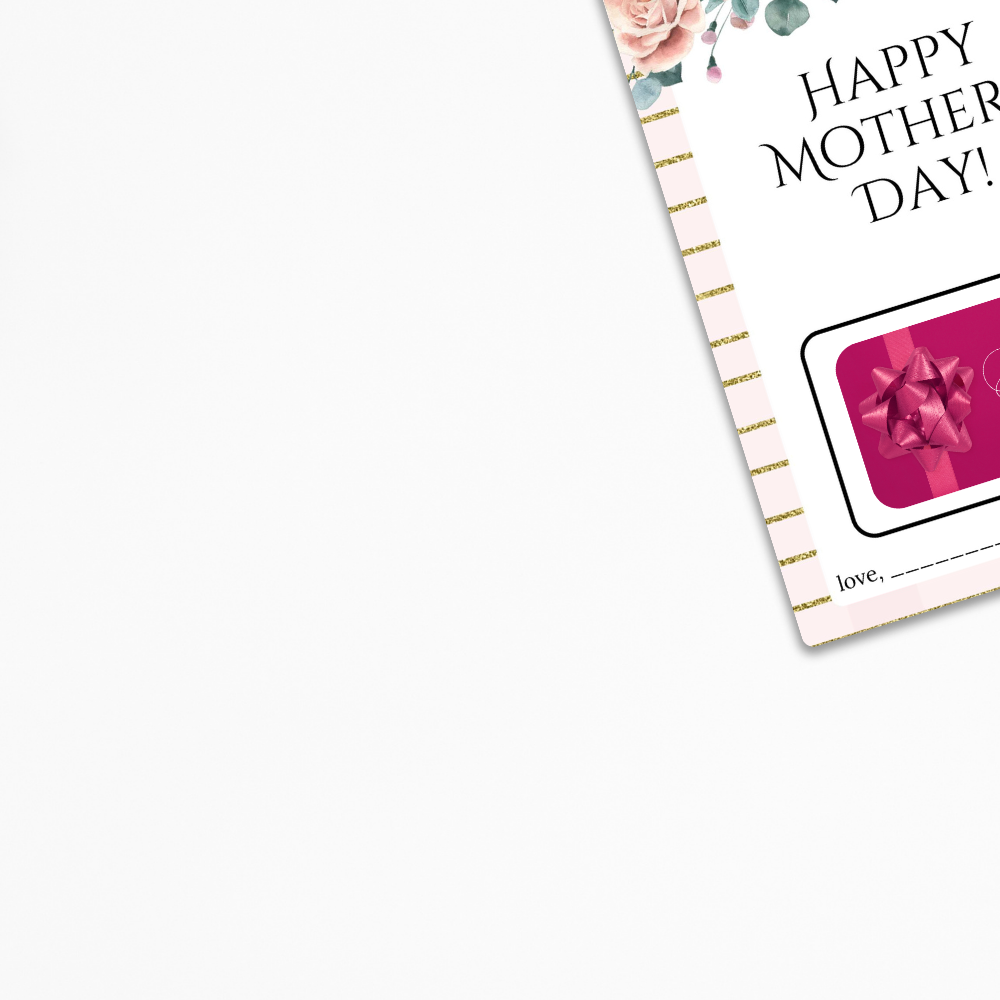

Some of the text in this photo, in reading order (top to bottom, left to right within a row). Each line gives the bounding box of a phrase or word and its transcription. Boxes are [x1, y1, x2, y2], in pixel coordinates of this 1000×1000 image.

[797, 20, 974, 122] HAPPY
[850, 146, 994, 224] DAY!
[835, 569, 884, 592] love,
